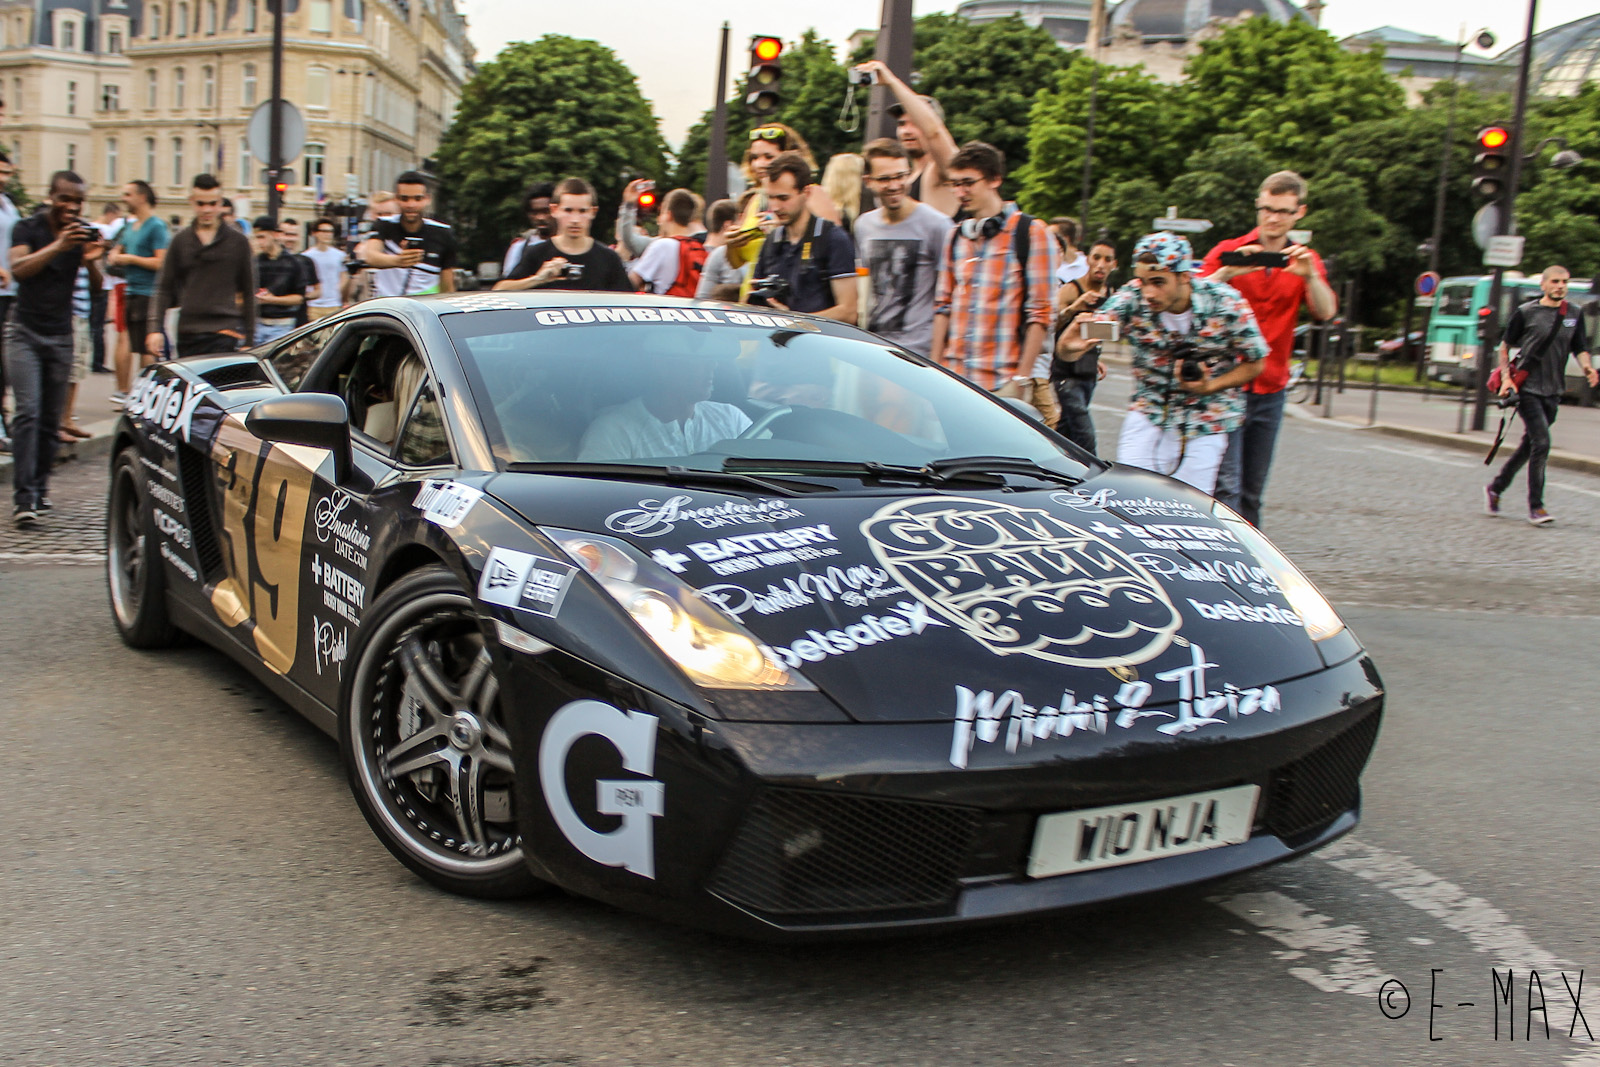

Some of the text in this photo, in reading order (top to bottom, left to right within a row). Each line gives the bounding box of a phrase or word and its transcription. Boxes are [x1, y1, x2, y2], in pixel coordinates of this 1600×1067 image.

[535, 307, 725, 327] GUMBALL
[314, 489, 371, 550] Anastasia
[604, 494, 790, 538] Anastasia
[694, 508, 807, 530] DATE.COM
[1050, 488, 1197, 514] Anastasia
[1121, 506, 1210, 521] DATE.COM
[686, 523, 839, 563] BATTERY
[1119, 523, 1240, 544] BATTERY
[334, 536, 368, 571] DATE.COM
[323, 561, 366, 610] BATTERY
[1186, 598, 1304, 627] betsafe
[1154, 642, 1281, 736] Ibiza
[538, 699, 666, 881] G
[1143, 798, 1217, 851] NJA
